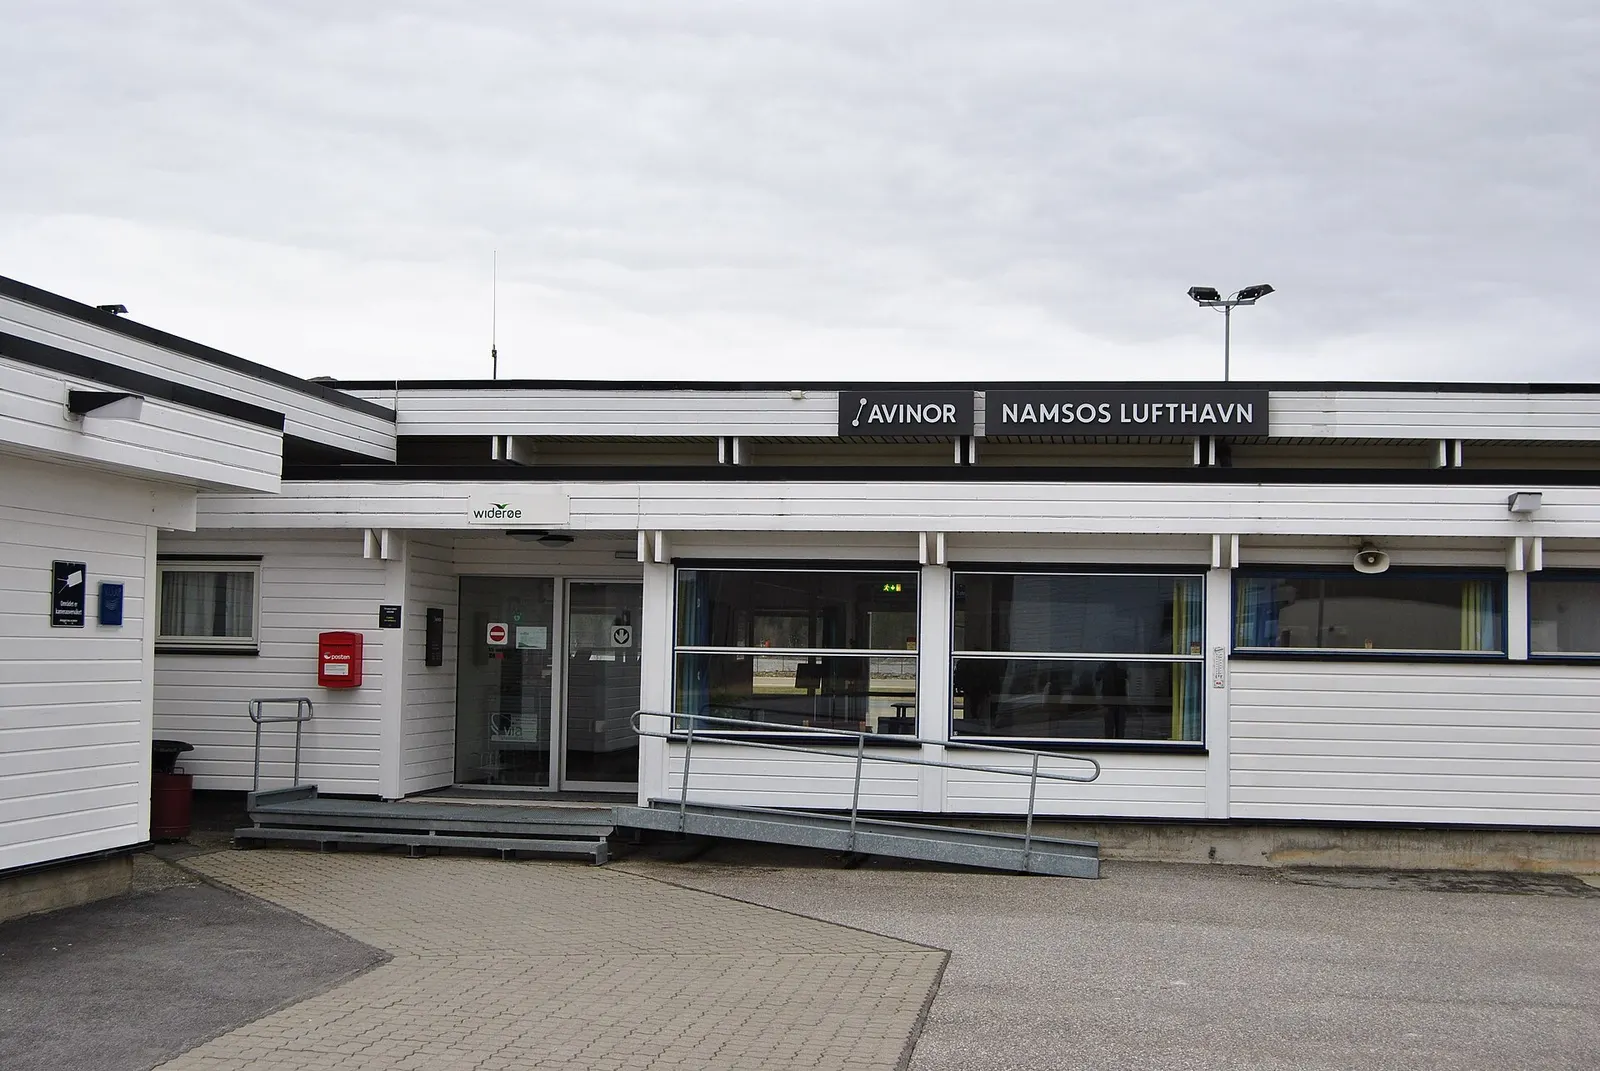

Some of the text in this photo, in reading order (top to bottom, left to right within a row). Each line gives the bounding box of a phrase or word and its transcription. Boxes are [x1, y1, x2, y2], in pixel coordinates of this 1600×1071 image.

[868, 404, 956, 423] AVINOR
[1002, 404, 1253, 423] NAMSOS LUFTHAVN
[473, 507, 522, 519] widerøe
